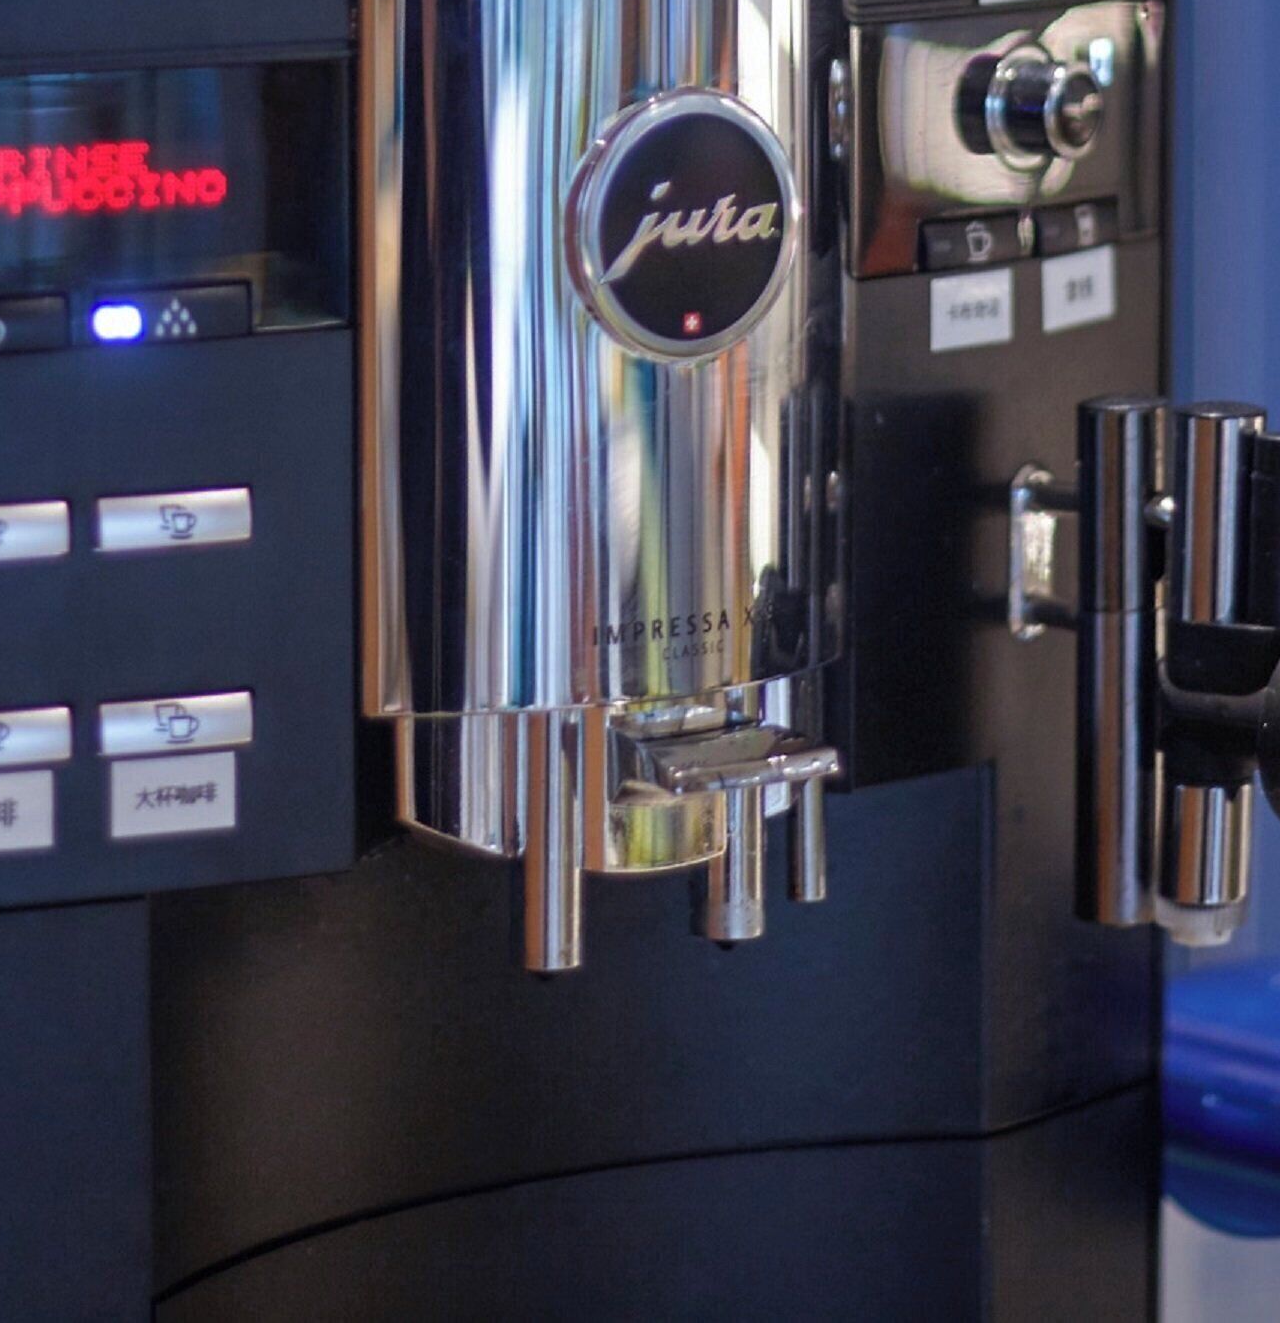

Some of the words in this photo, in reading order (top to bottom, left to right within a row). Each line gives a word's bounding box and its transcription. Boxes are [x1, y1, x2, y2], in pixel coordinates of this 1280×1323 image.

[599, 180, 778, 285] jura
[593, 609, 729, 646] IMPRESSA
[662, 639, 725, 661] CLASSIC
[135, 782, 218, 810] 大杯咖啡
